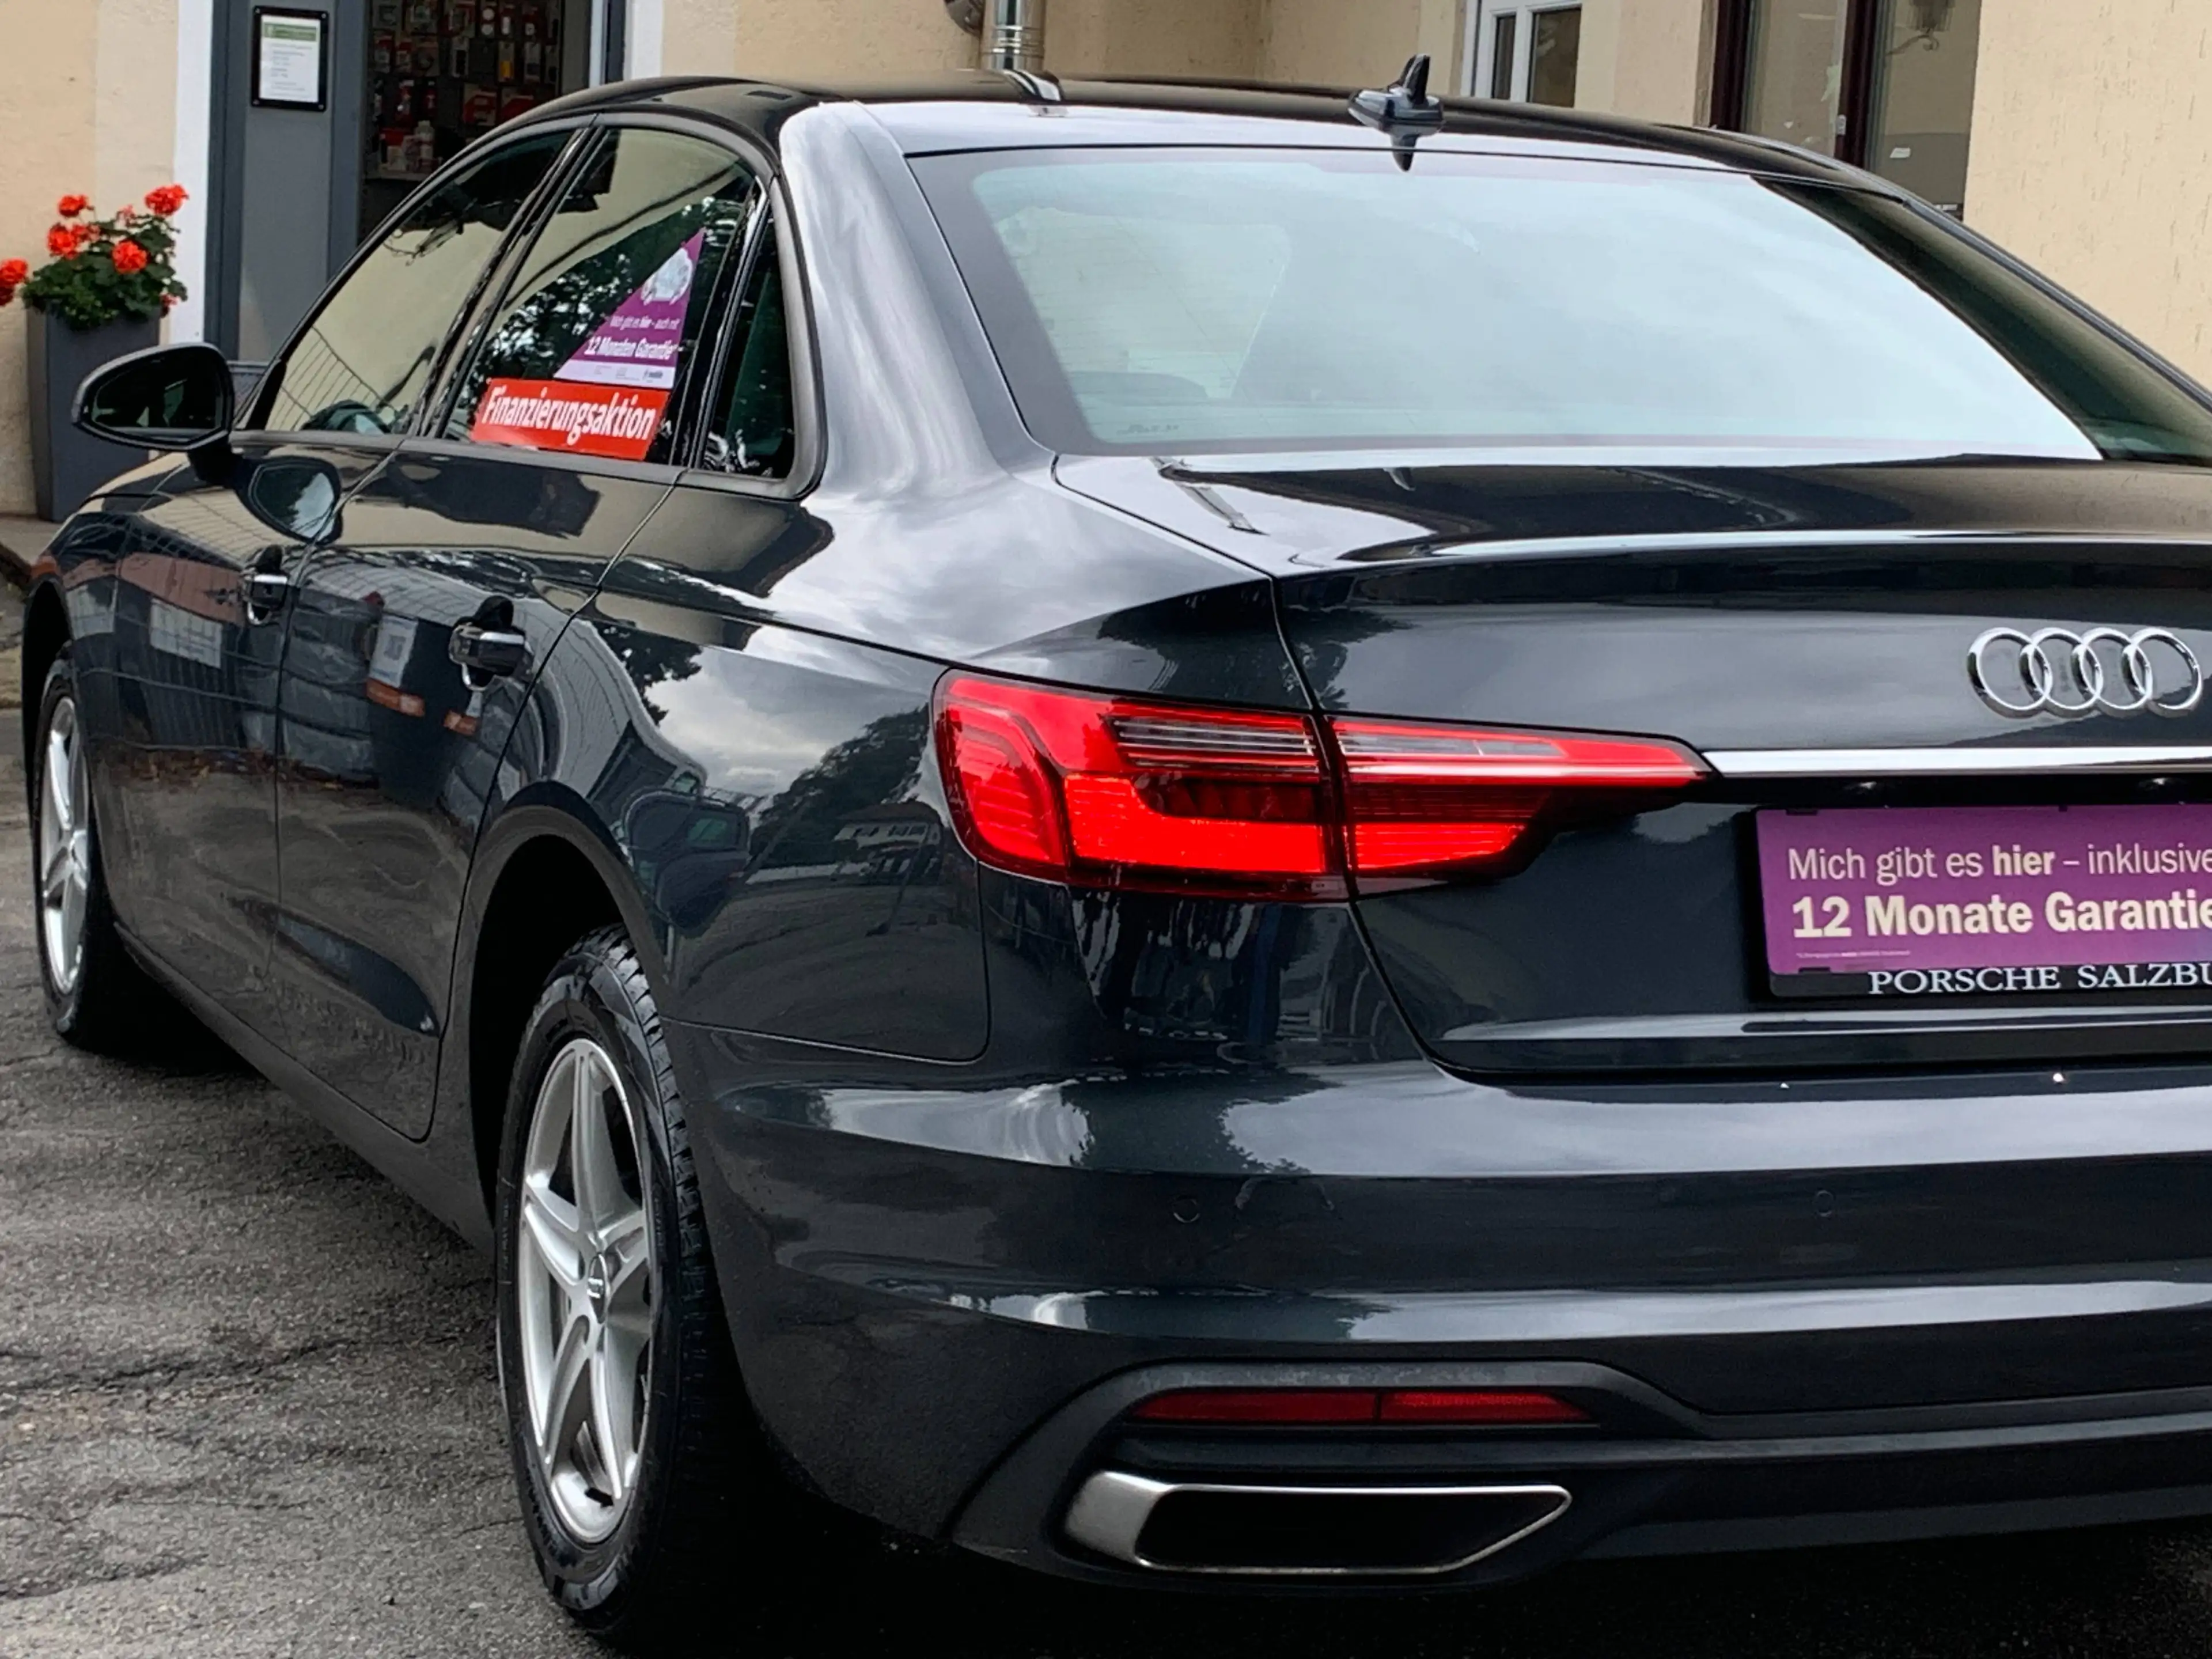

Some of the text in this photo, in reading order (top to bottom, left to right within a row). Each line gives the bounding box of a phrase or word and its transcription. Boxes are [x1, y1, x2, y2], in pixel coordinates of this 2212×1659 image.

[584, 336, 601, 355] 12
[481, 384, 656, 445] Finanzierungsaktion
[1788, 847, 1866, 880] Mich
[1876, 846, 1938, 886] gibt
[1945, 851, 1984, 878] es
[1991, 844, 2055, 876] hier
[1792, 896, 1853, 938] 12
[1864, 893, 2035, 937] Monate
[1868, 965, 2061, 995] PORSCHE
